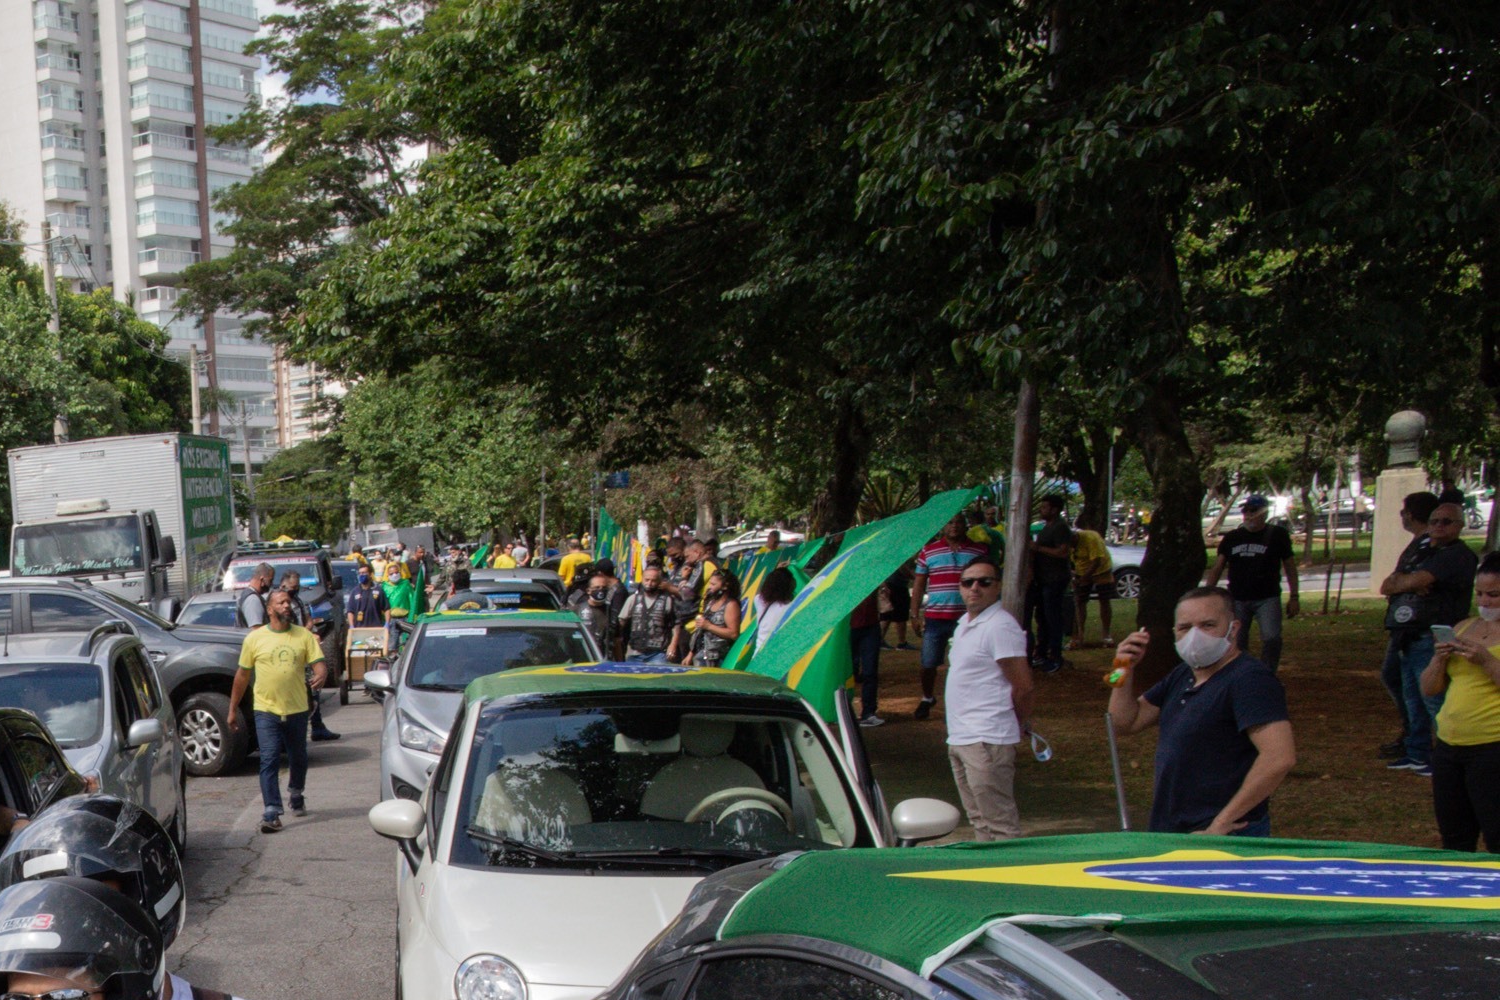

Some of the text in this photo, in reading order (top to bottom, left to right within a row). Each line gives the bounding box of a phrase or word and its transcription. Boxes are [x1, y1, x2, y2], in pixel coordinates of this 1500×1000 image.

[20, 557, 135, 576] Minhas Filhos Minha Vida
